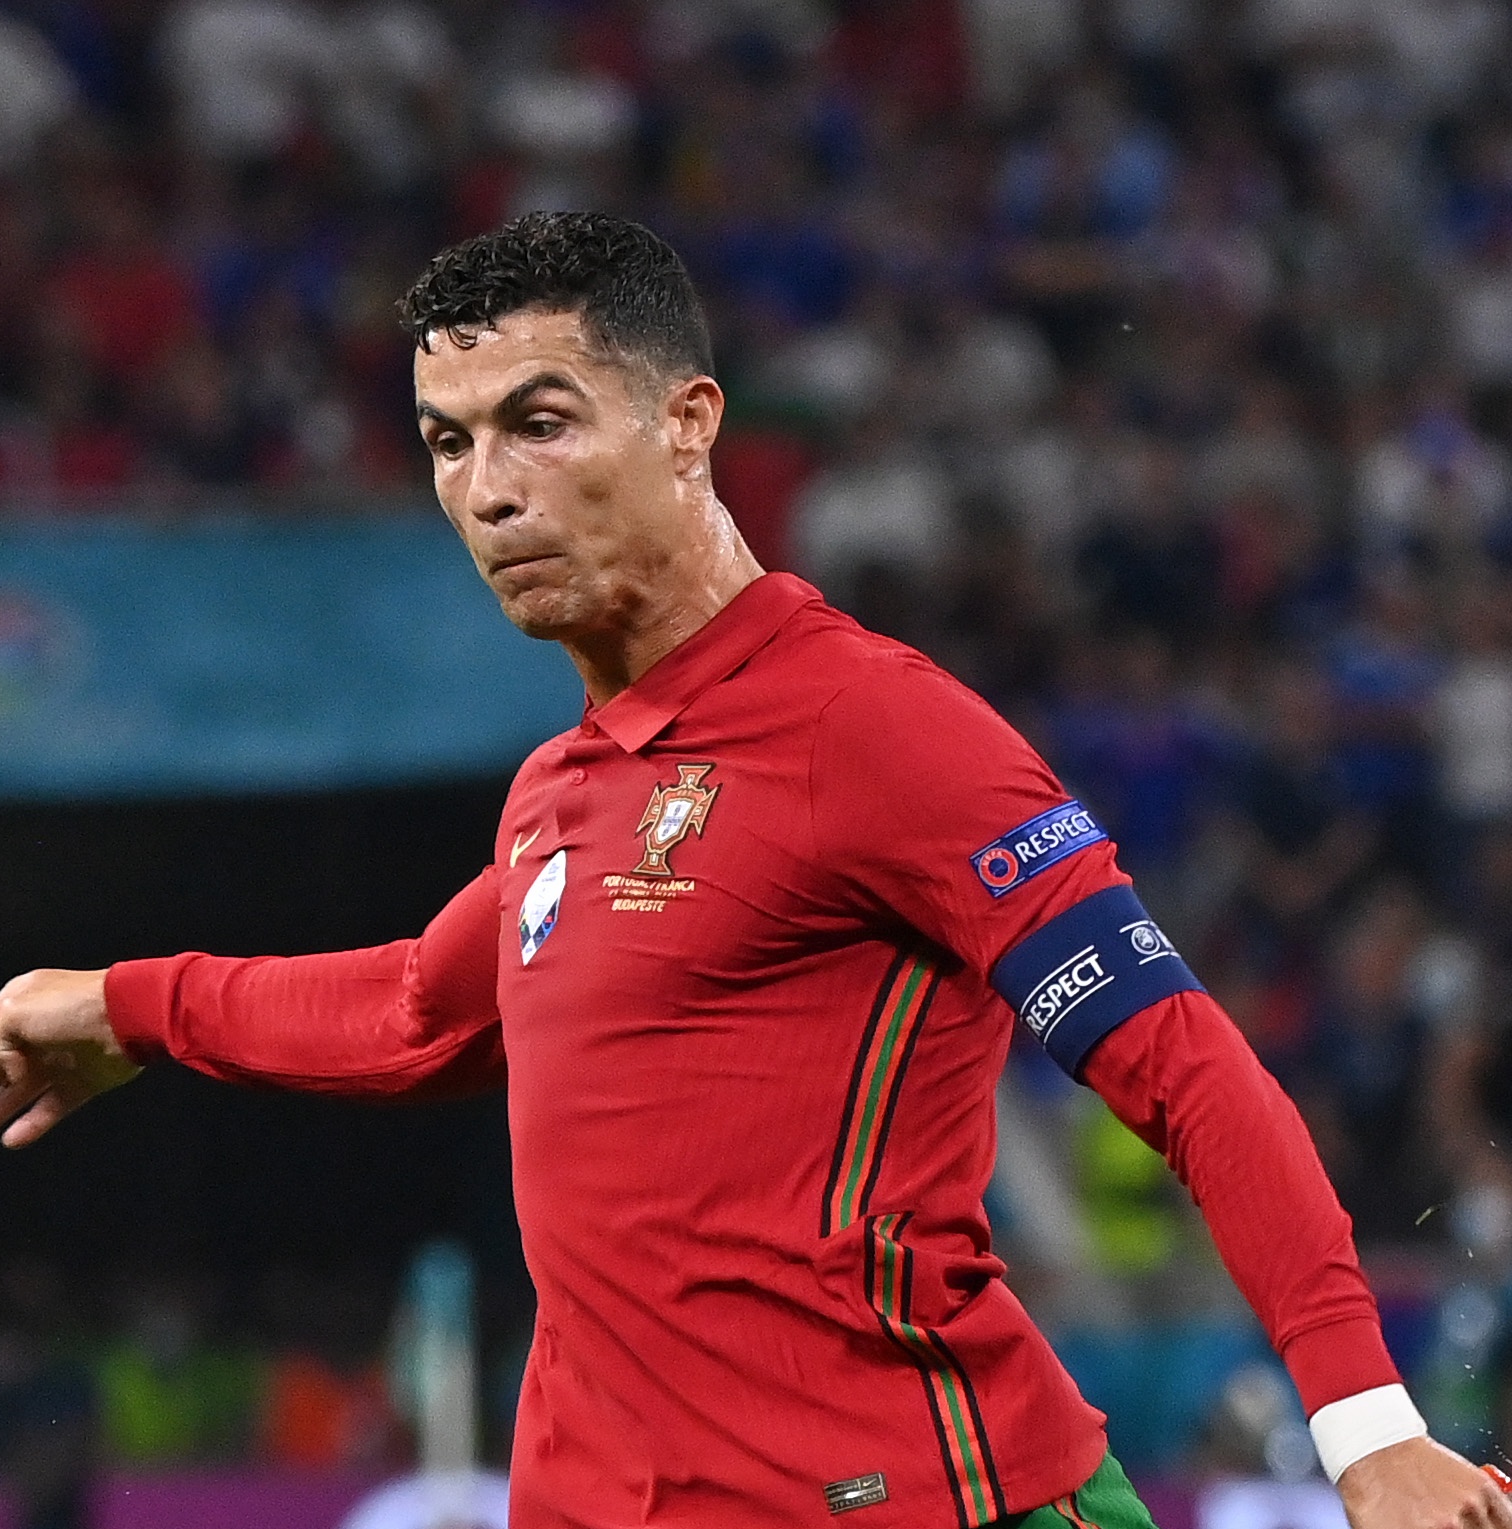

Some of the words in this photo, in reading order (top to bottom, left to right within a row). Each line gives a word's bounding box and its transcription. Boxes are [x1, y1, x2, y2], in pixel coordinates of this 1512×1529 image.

[1014, 810, 1096, 863] RESPECT
[611, 898, 666, 912] BUDAPESTE
[1025, 952, 1105, 1037] RESPECT
